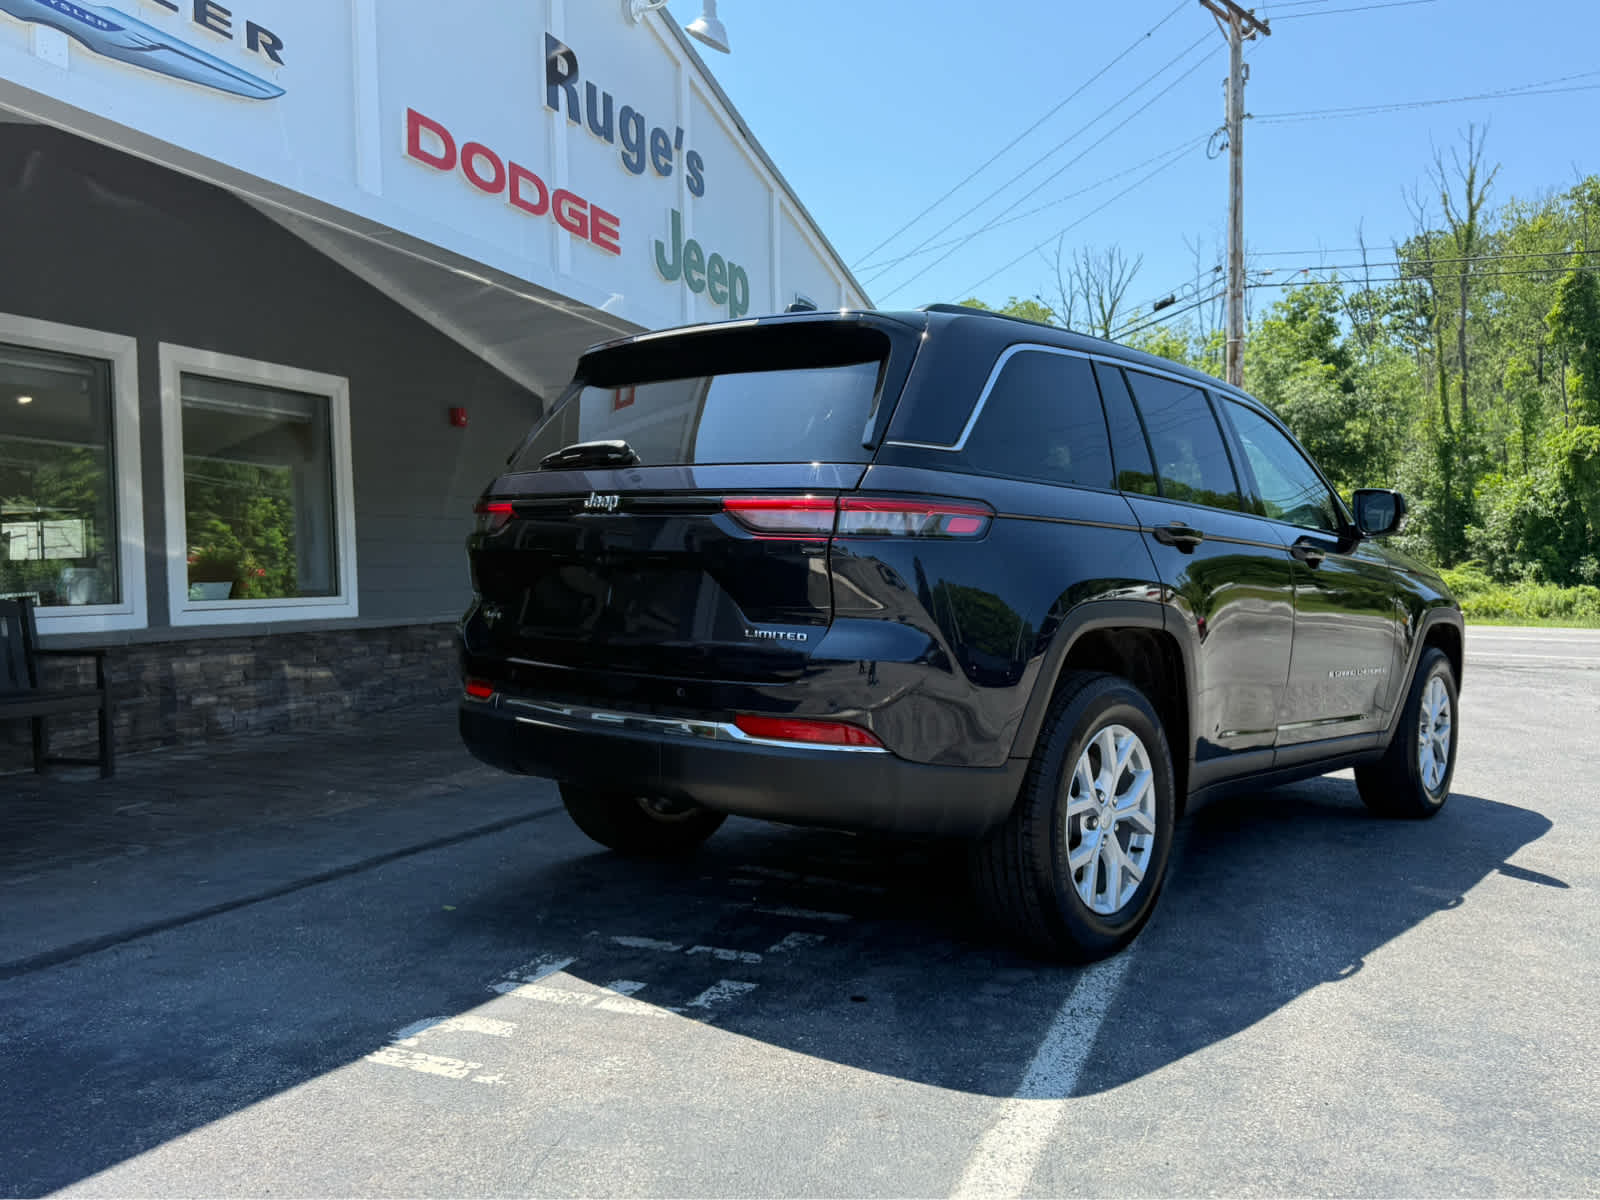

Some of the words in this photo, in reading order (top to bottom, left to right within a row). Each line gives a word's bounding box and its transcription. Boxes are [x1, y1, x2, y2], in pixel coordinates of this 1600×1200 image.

[545, 31, 705, 198] Ruge's
[407, 107, 621, 256] DODGE
[654, 208, 750, 319] Jeep
[584, 492, 620, 511] Jeep
[744, 629, 807, 641] LIMITED
